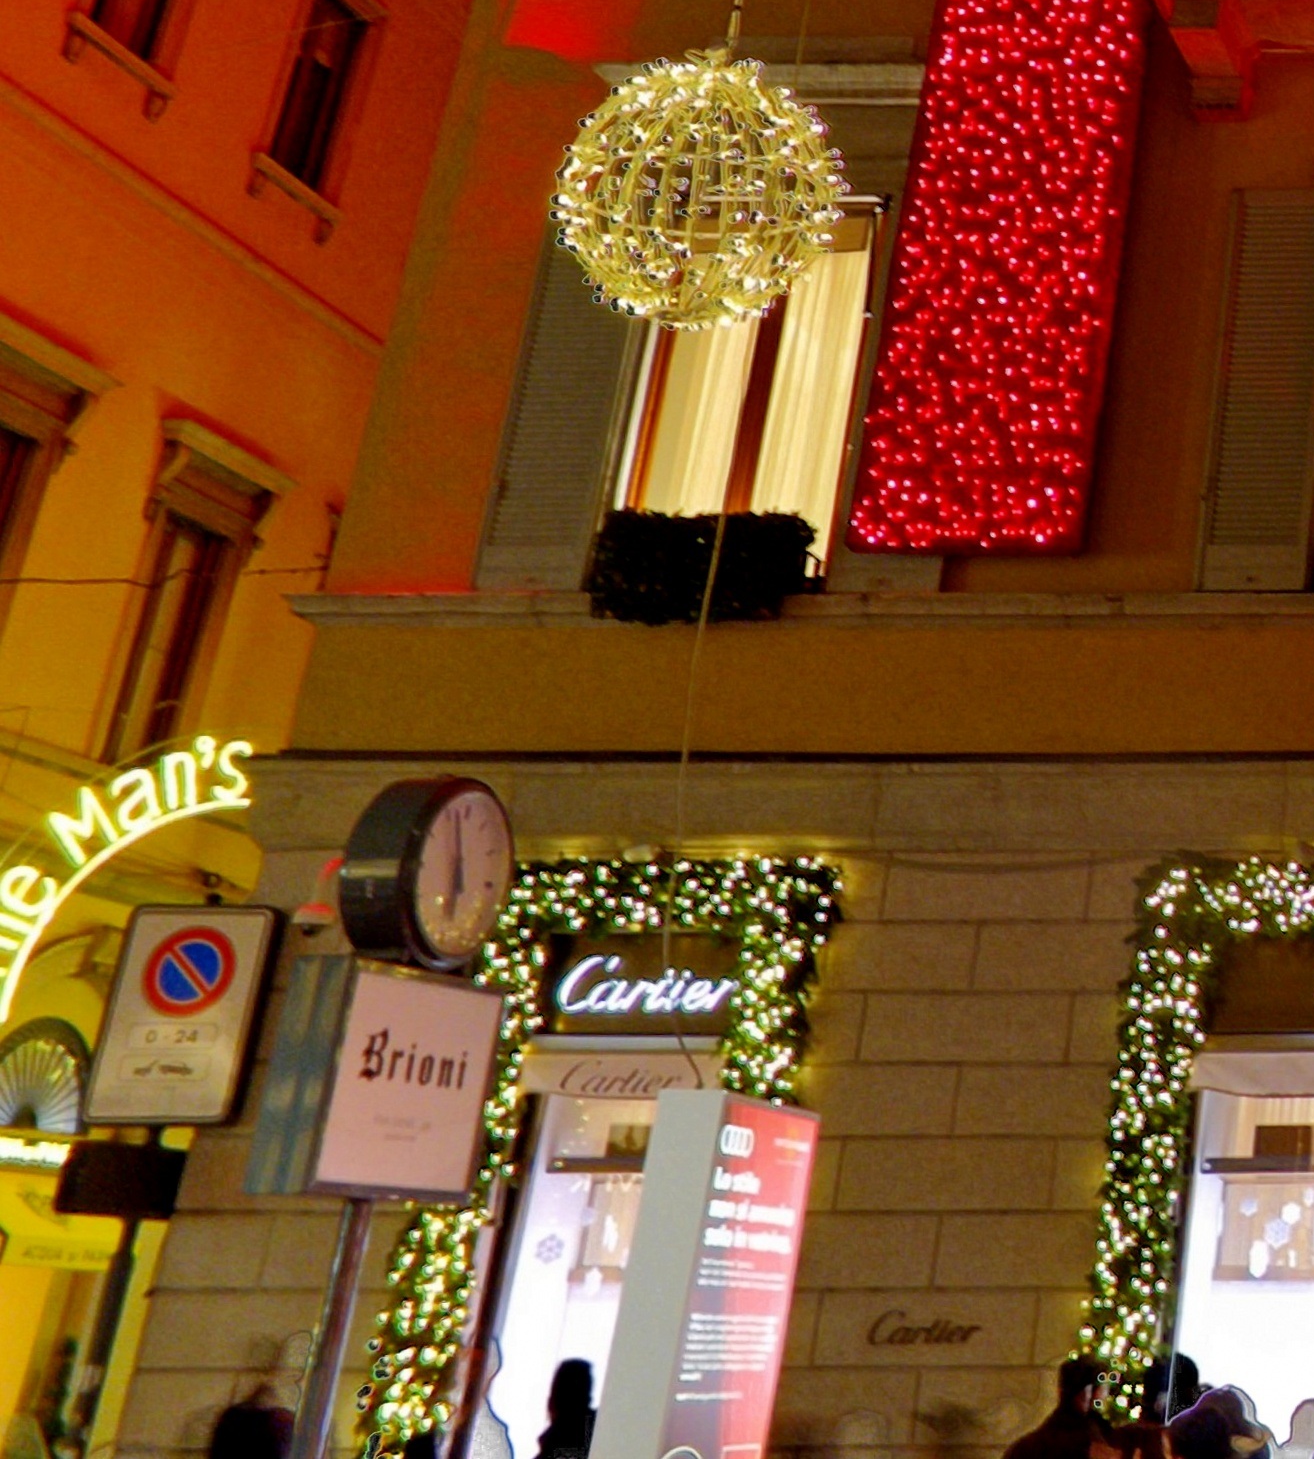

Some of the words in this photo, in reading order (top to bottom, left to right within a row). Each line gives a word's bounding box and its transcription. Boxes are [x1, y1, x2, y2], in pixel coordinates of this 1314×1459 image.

[48, 735, 253, 867] Man's
[558, 955, 740, 1015] Cartier
[360, 1028, 468, 1090] Brioni
[560, 1060, 682, 1094] Cartier
[866, 1308, 982, 1345] Cartier
